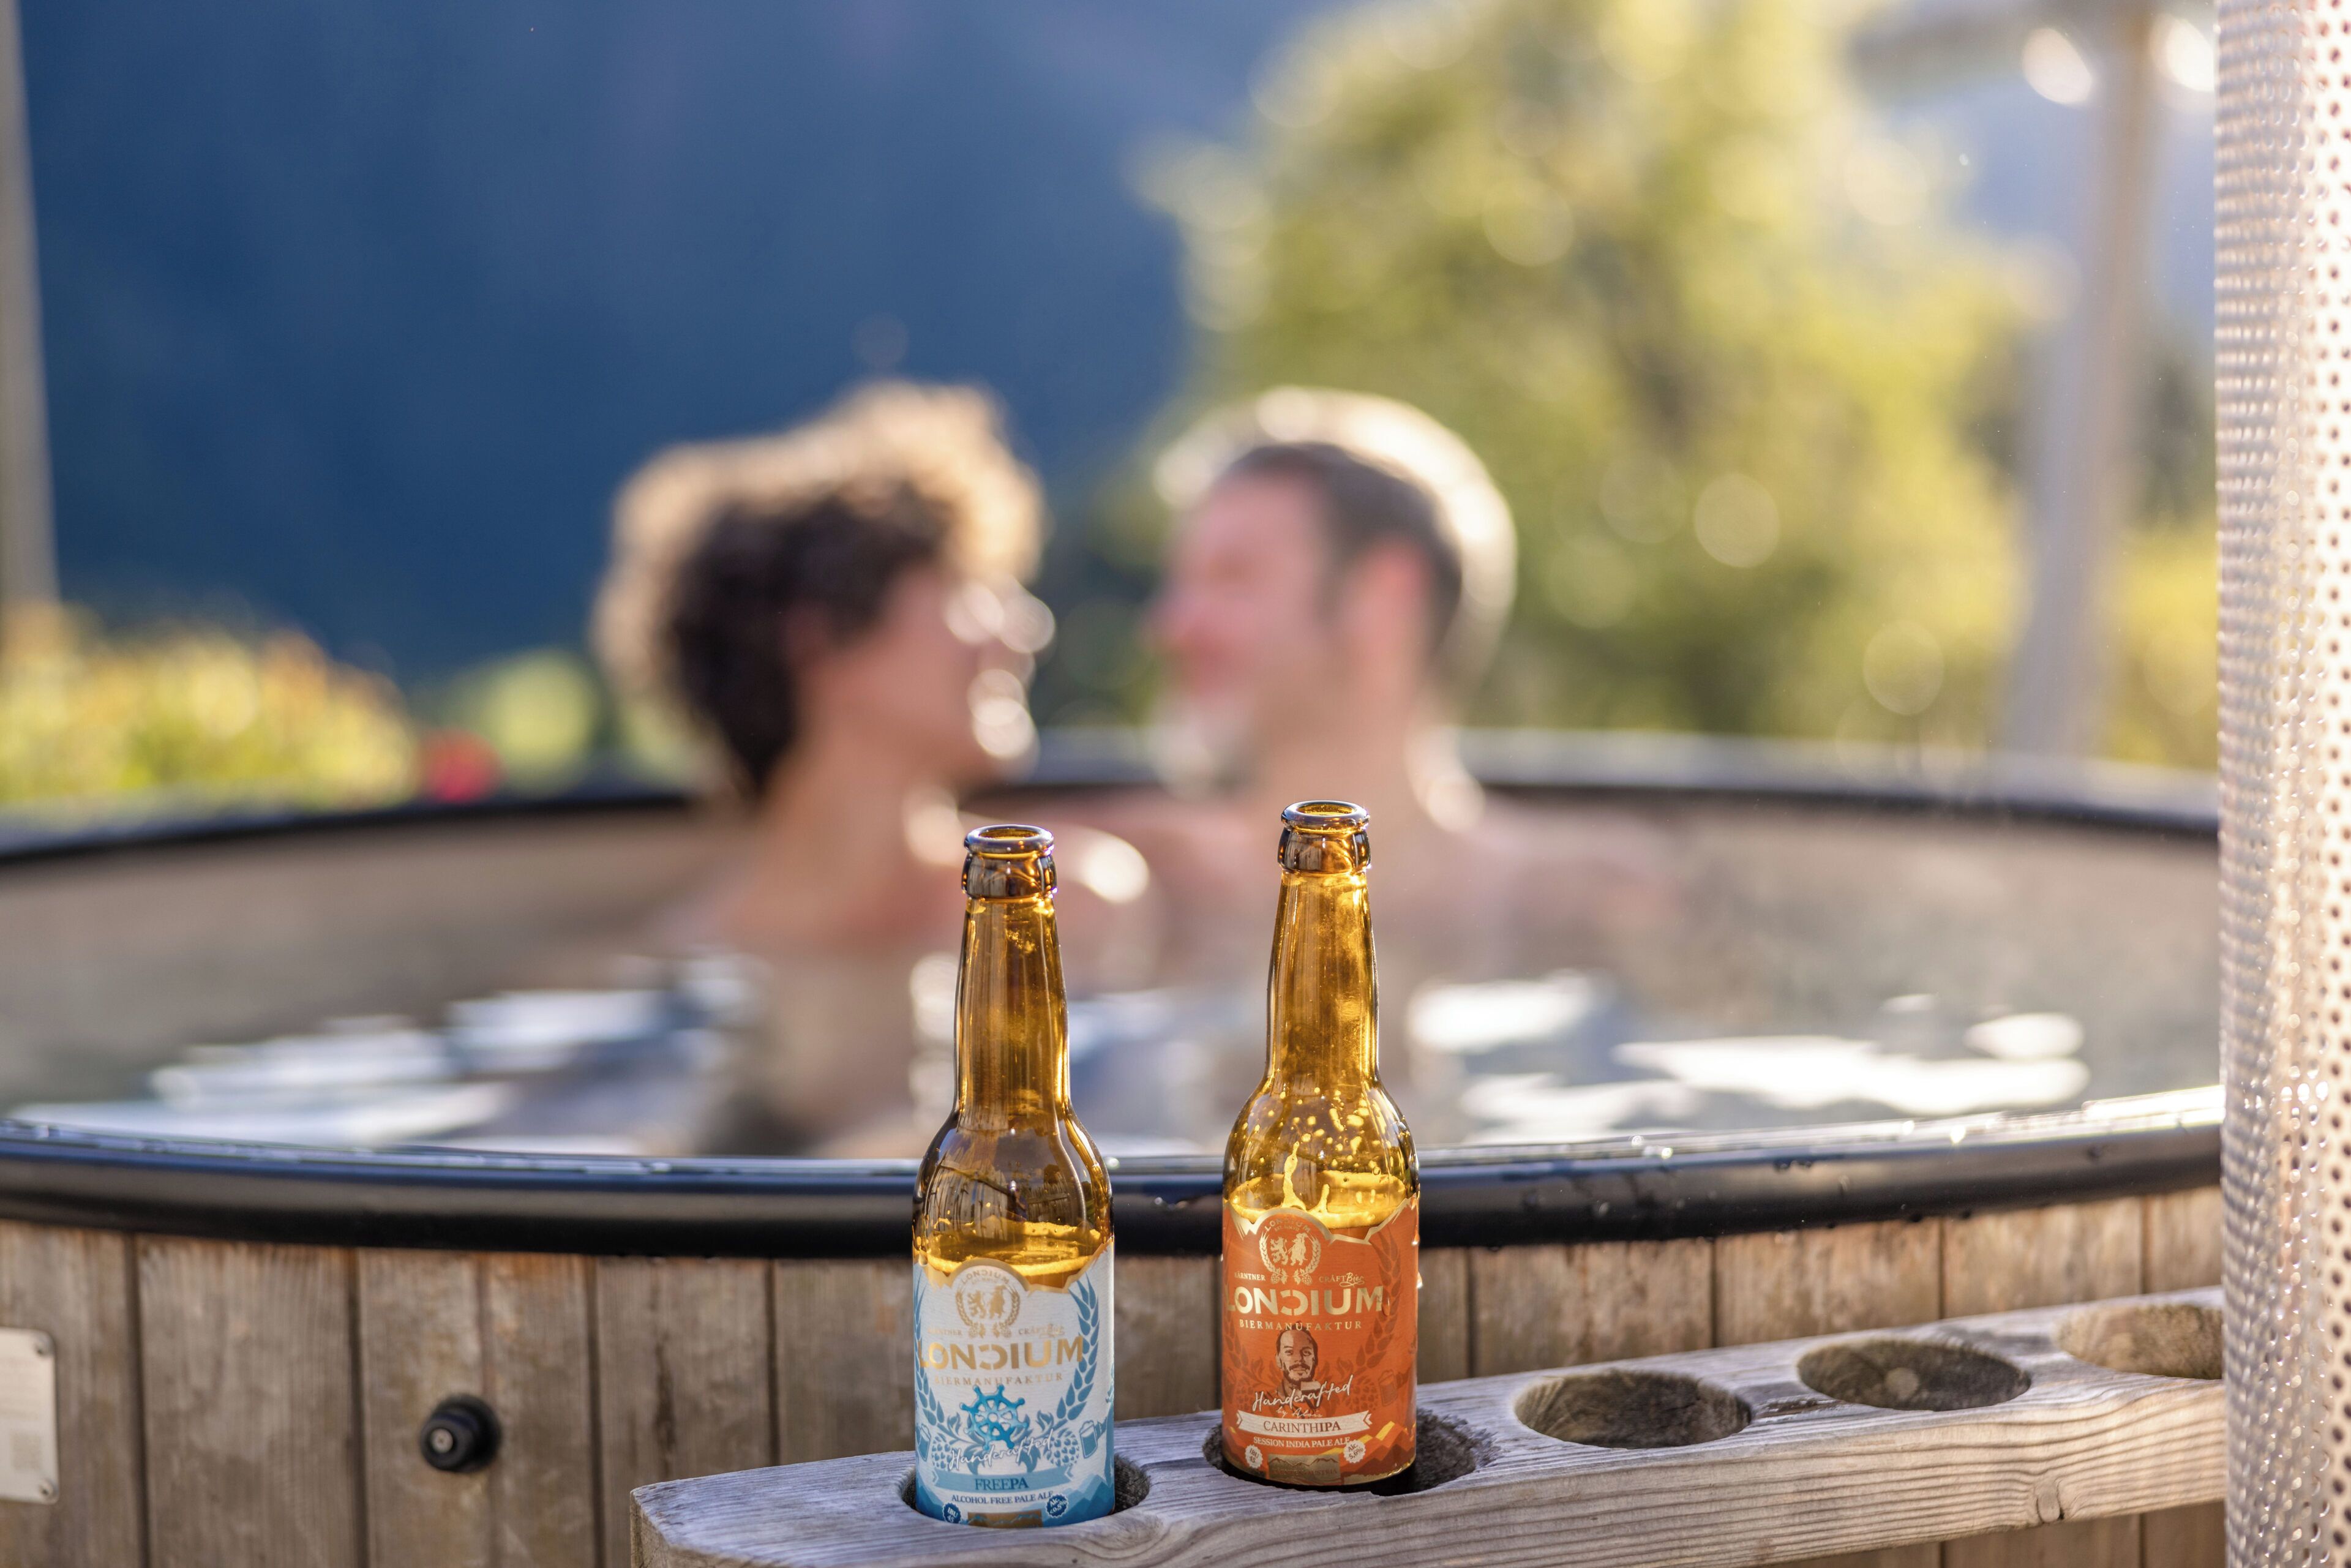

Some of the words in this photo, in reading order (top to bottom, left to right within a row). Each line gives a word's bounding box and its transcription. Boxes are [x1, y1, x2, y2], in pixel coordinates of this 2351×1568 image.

[1239, 1319, 1362, 1331] BIERMANUFAKTUR
[935, 1373, 1062, 1386] BIERMANUFAKTUR
[1252, 1375, 1354, 1412] Handcrafted
[1276, 1406, 1288, 1419] by
[1264, 1421, 1341, 1433] CARINTHIPA
[1253, 1436, 1284, 1447] SESSION
[1311, 1439, 1333, 1447] PALE
[1334, 1436, 1351, 1445] ALE
[949, 1428, 1054, 1471] Handcrafted
[975, 1477, 1029, 1490] FREEPA
[951, 1495, 989, 1504] ALCOHOL
